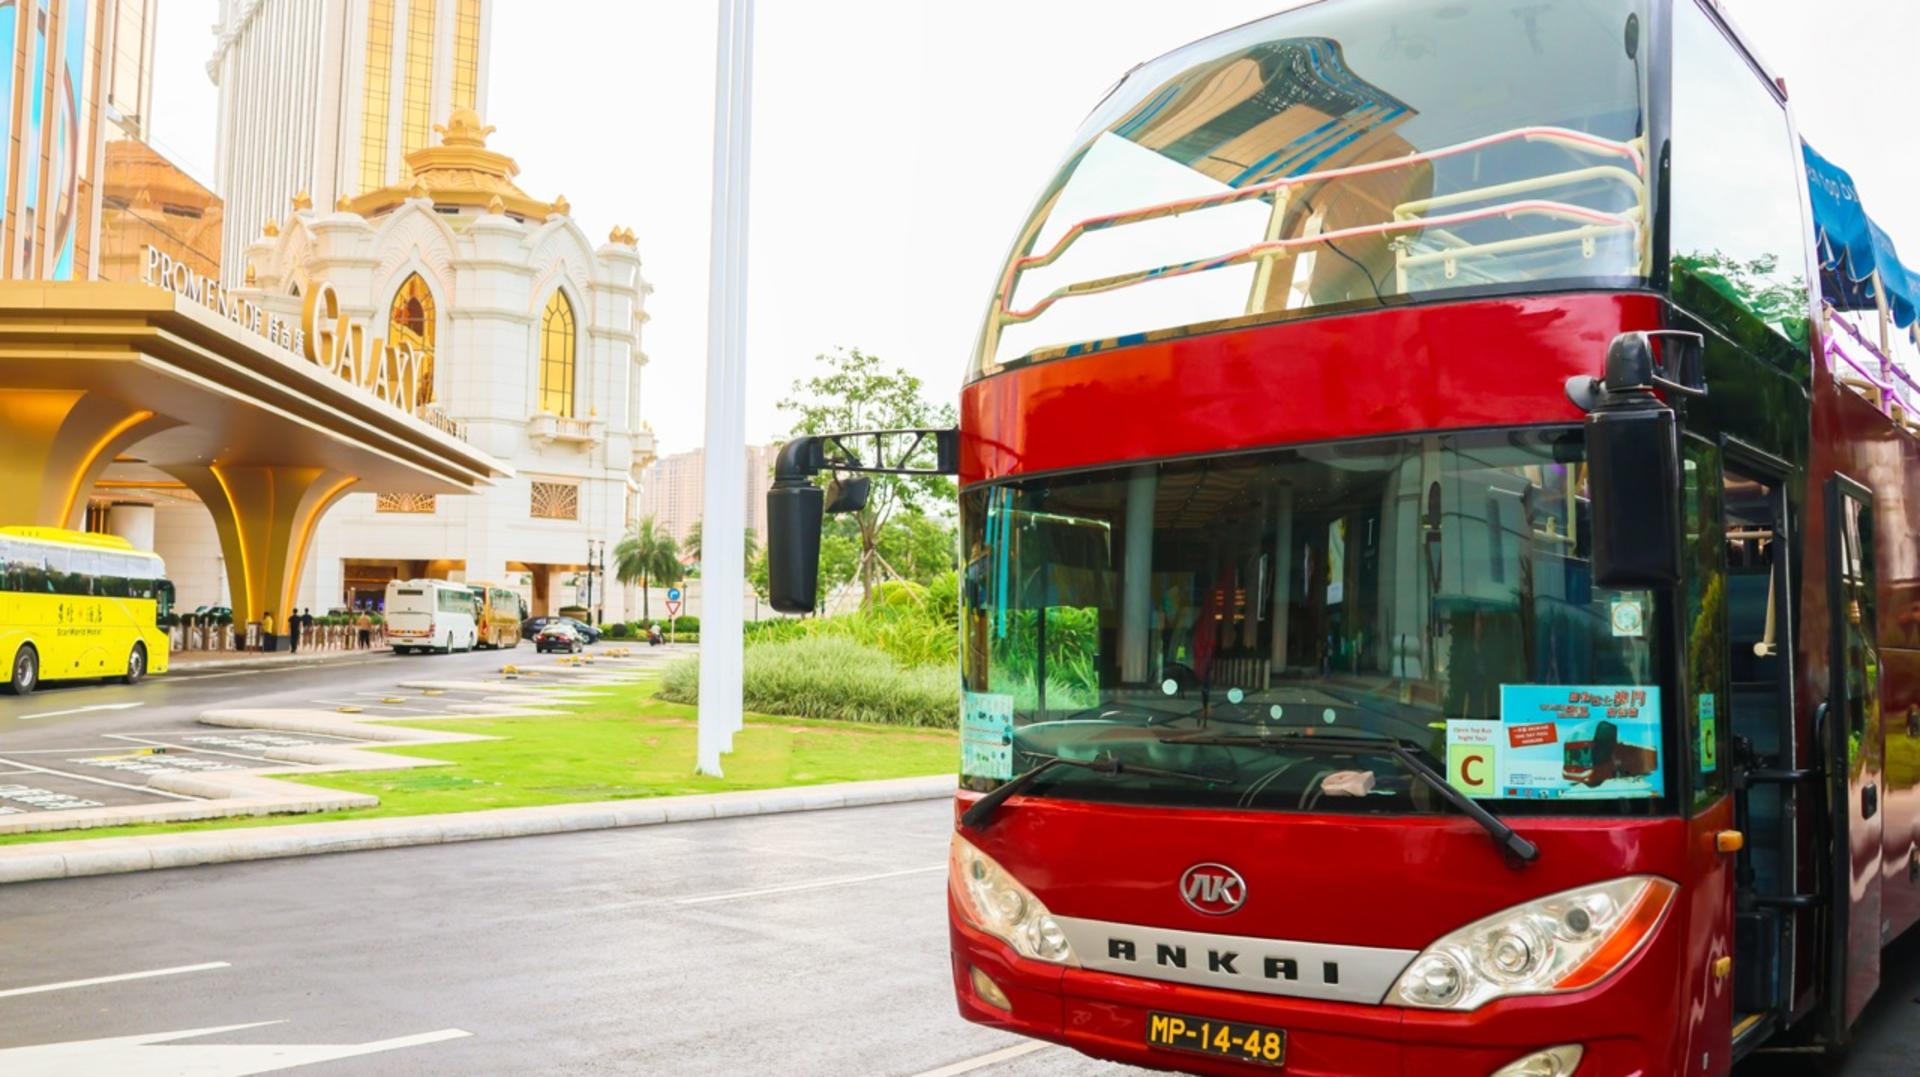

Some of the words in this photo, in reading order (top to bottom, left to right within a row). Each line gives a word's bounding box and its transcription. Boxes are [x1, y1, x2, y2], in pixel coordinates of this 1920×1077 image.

[144, 244, 262, 336] PROMENADE
[302, 281, 425, 418] GALAXY
[1460, 755, 1484, 786] C
[1107, 937, 1339, 985] ANKAI
[1150, 1014, 1281, 1061] MP-14-48
